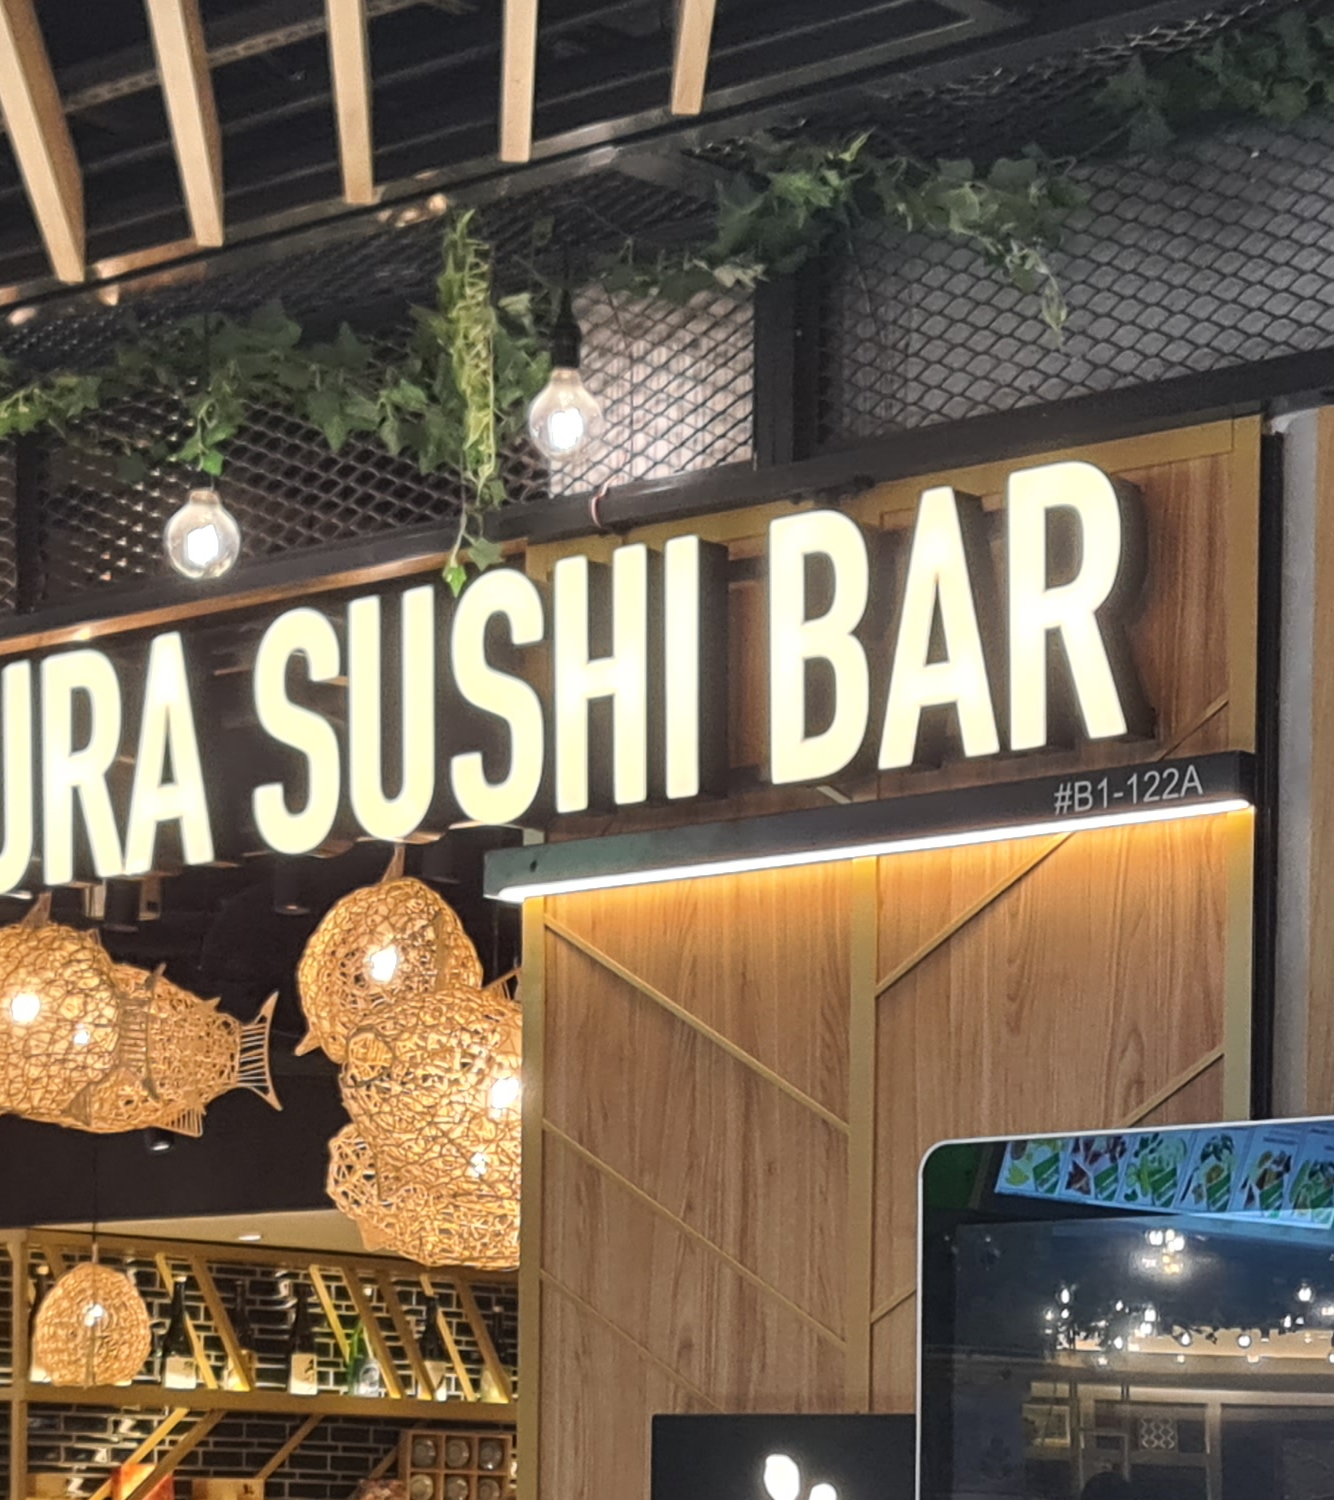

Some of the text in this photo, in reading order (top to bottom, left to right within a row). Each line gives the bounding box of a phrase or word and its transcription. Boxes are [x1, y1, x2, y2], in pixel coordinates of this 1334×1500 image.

[253, 533, 701, 858] SUSHI
[769, 460, 1129, 787] BAR
[1054, 764, 1204, 815] #B1-122A
